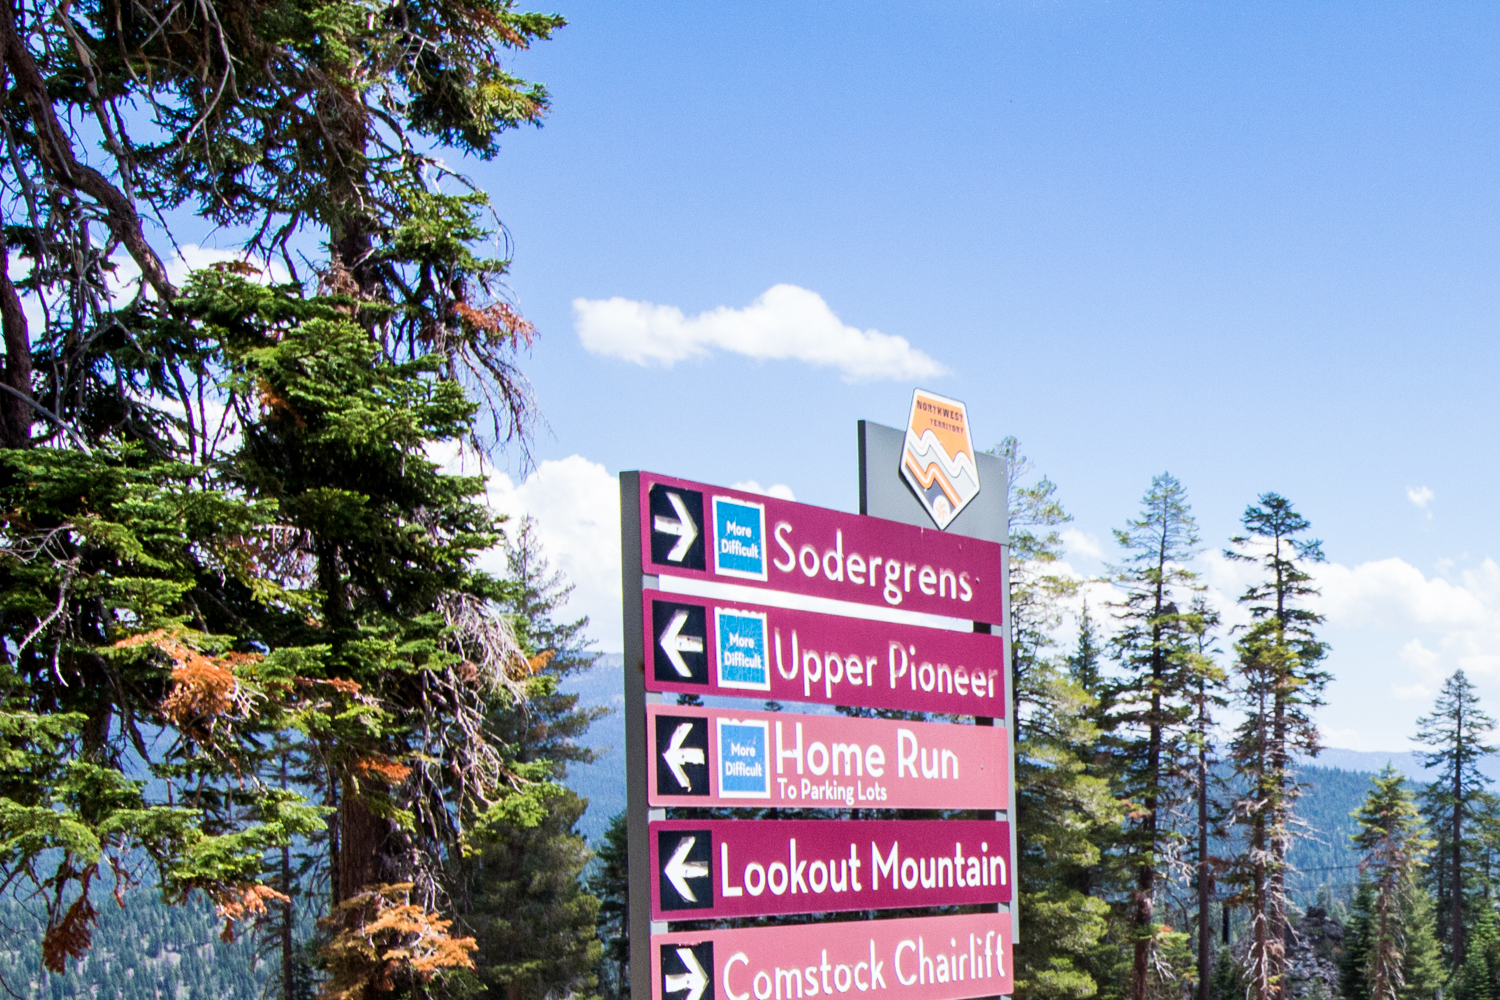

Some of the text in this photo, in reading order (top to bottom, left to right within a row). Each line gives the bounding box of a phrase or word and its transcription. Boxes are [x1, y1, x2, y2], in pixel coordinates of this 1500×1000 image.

[930, 419, 964, 434] TERRITORY
[726, 520, 752, 538] More
[721, 539, 759, 559] Difficult
[772, 521, 973, 605] Sodergrens
[729, 631, 755, 649] More
[724, 652, 762, 670] Difficult
[774, 627, 999, 698] Upper Pioneer
[731, 740, 756, 758] More
[775, 720, 959, 780] Home Run
[725, 760, 762, 778] Difficult
[777, 777, 887, 805] To Parking Lots
[720, 838, 1007, 897] Lookout Mountain
[894, 930, 1005, 986] Chairlift
